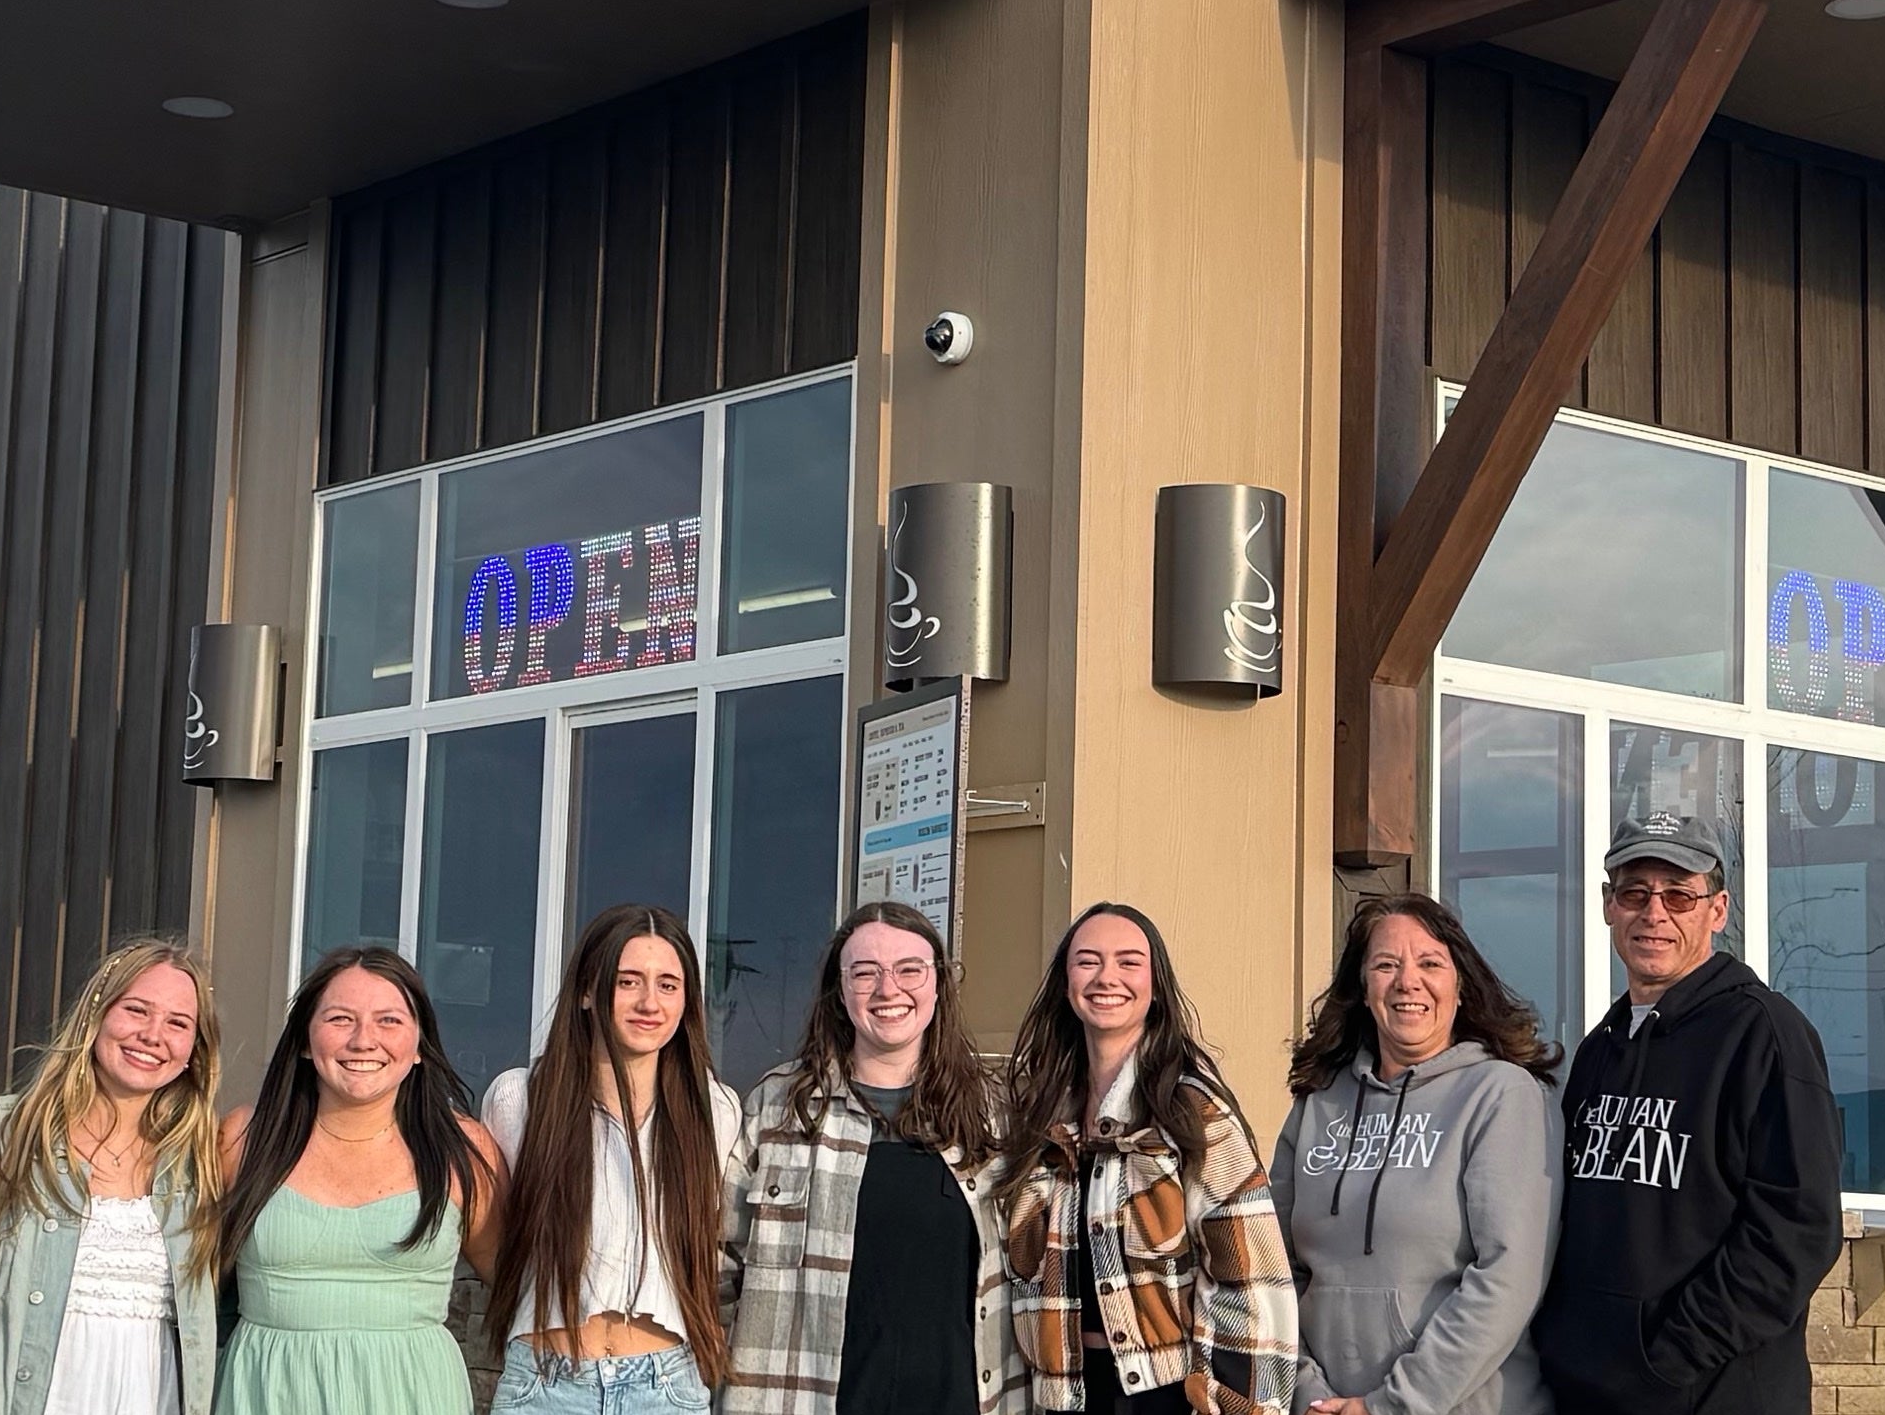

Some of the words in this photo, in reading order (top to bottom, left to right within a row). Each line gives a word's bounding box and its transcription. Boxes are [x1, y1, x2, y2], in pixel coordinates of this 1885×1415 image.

[464, 516, 701, 694] OPEN
[1331, 1130, 1445, 1171] BEAN
[1355, 1113, 1432, 1137] HUMAN
[1574, 1124, 1693, 1190] BEAN
